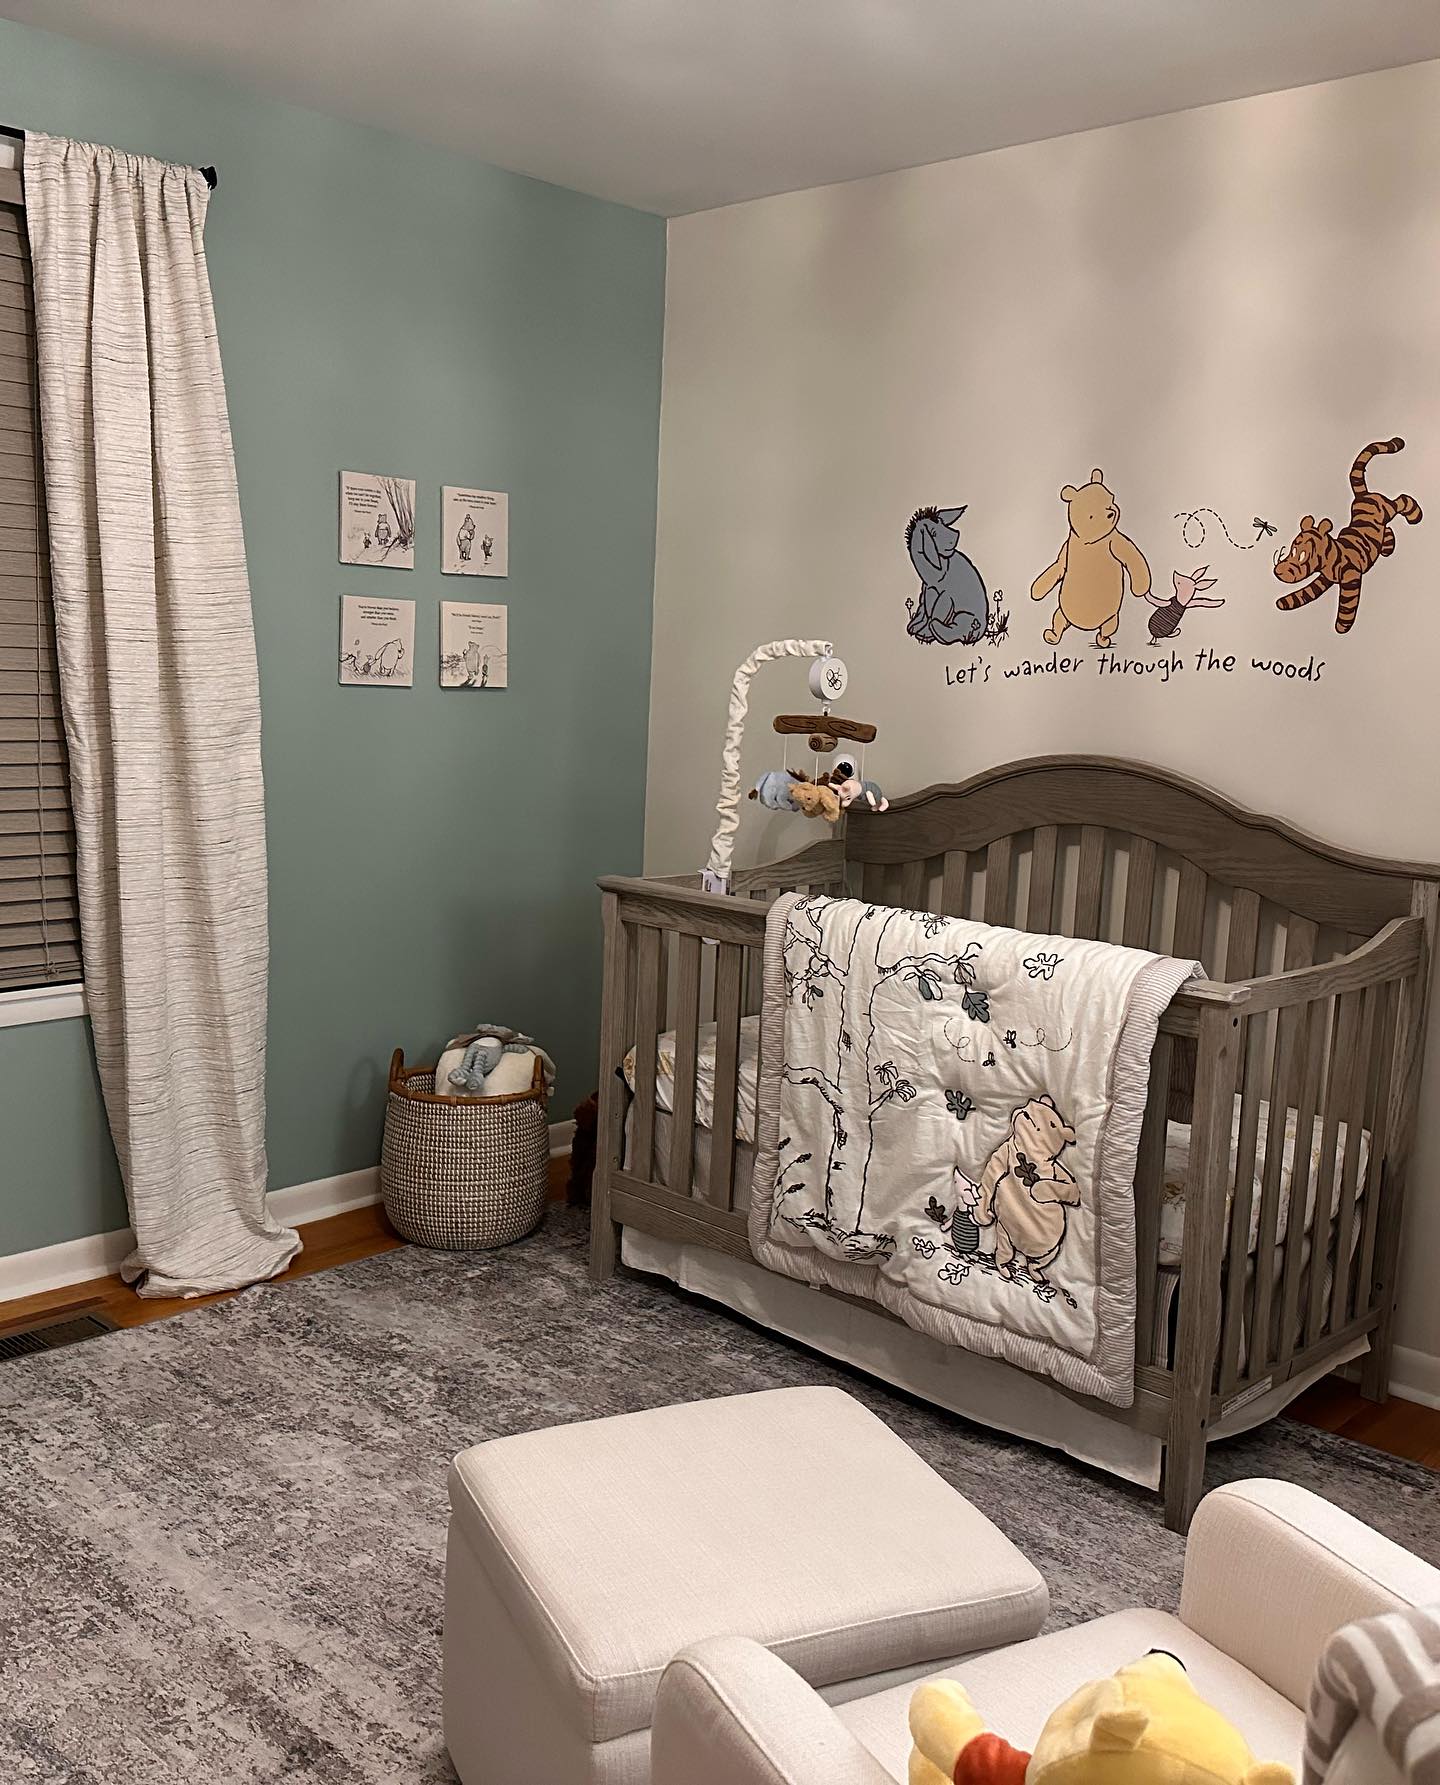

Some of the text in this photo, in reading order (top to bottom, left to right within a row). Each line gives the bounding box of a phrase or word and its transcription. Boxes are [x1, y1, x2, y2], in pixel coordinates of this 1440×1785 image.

[944, 648, 1326, 686] Let's wander through the woods
